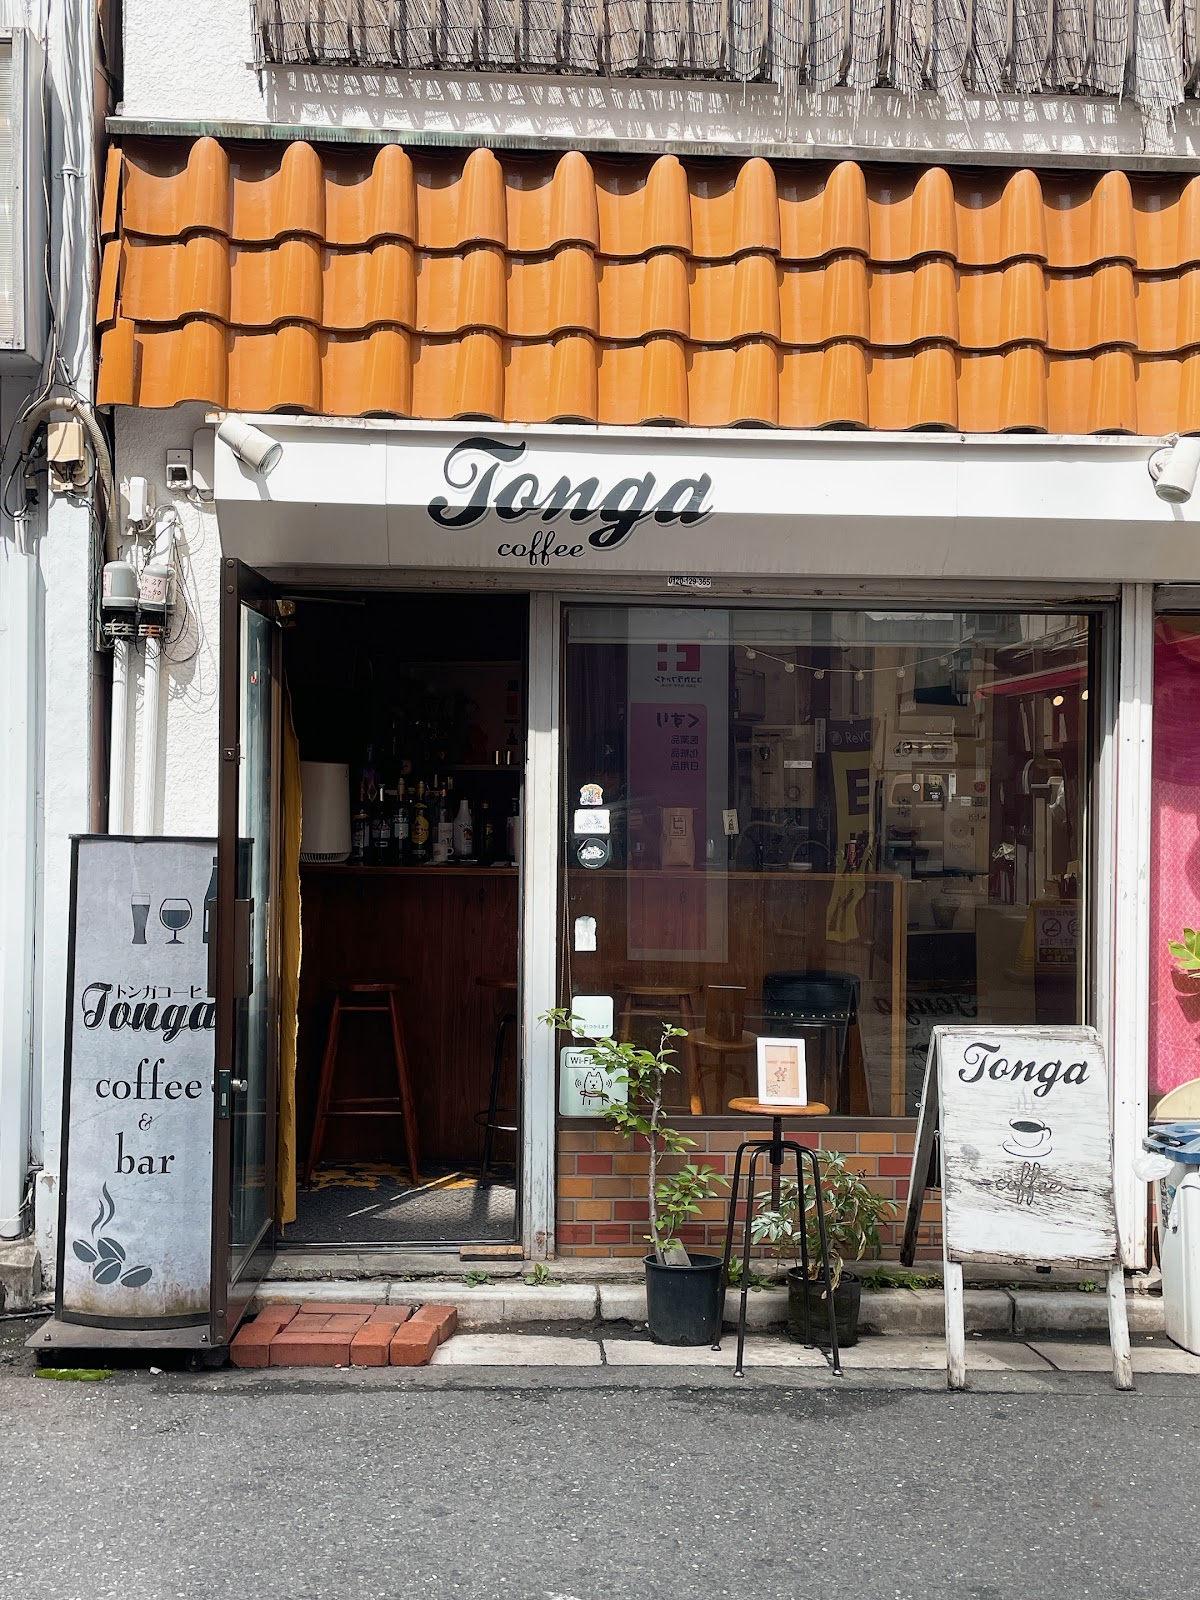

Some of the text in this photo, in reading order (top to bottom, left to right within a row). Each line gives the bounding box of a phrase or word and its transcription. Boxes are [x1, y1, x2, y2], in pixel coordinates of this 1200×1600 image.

[427, 436, 714, 550] Tonga
[497, 531, 586, 566] coffee
[82, 982, 216, 1043] Tonga
[117, 984, 208, 1000] トンガコーヒ
[96, 1057, 203, 1101] coffee
[958, 1042, 1090, 1097] Tonga
[138, 1112, 153, 1132] &
[114, 1131, 175, 1176] bar
[995, 1161, 1064, 1206] coffee
